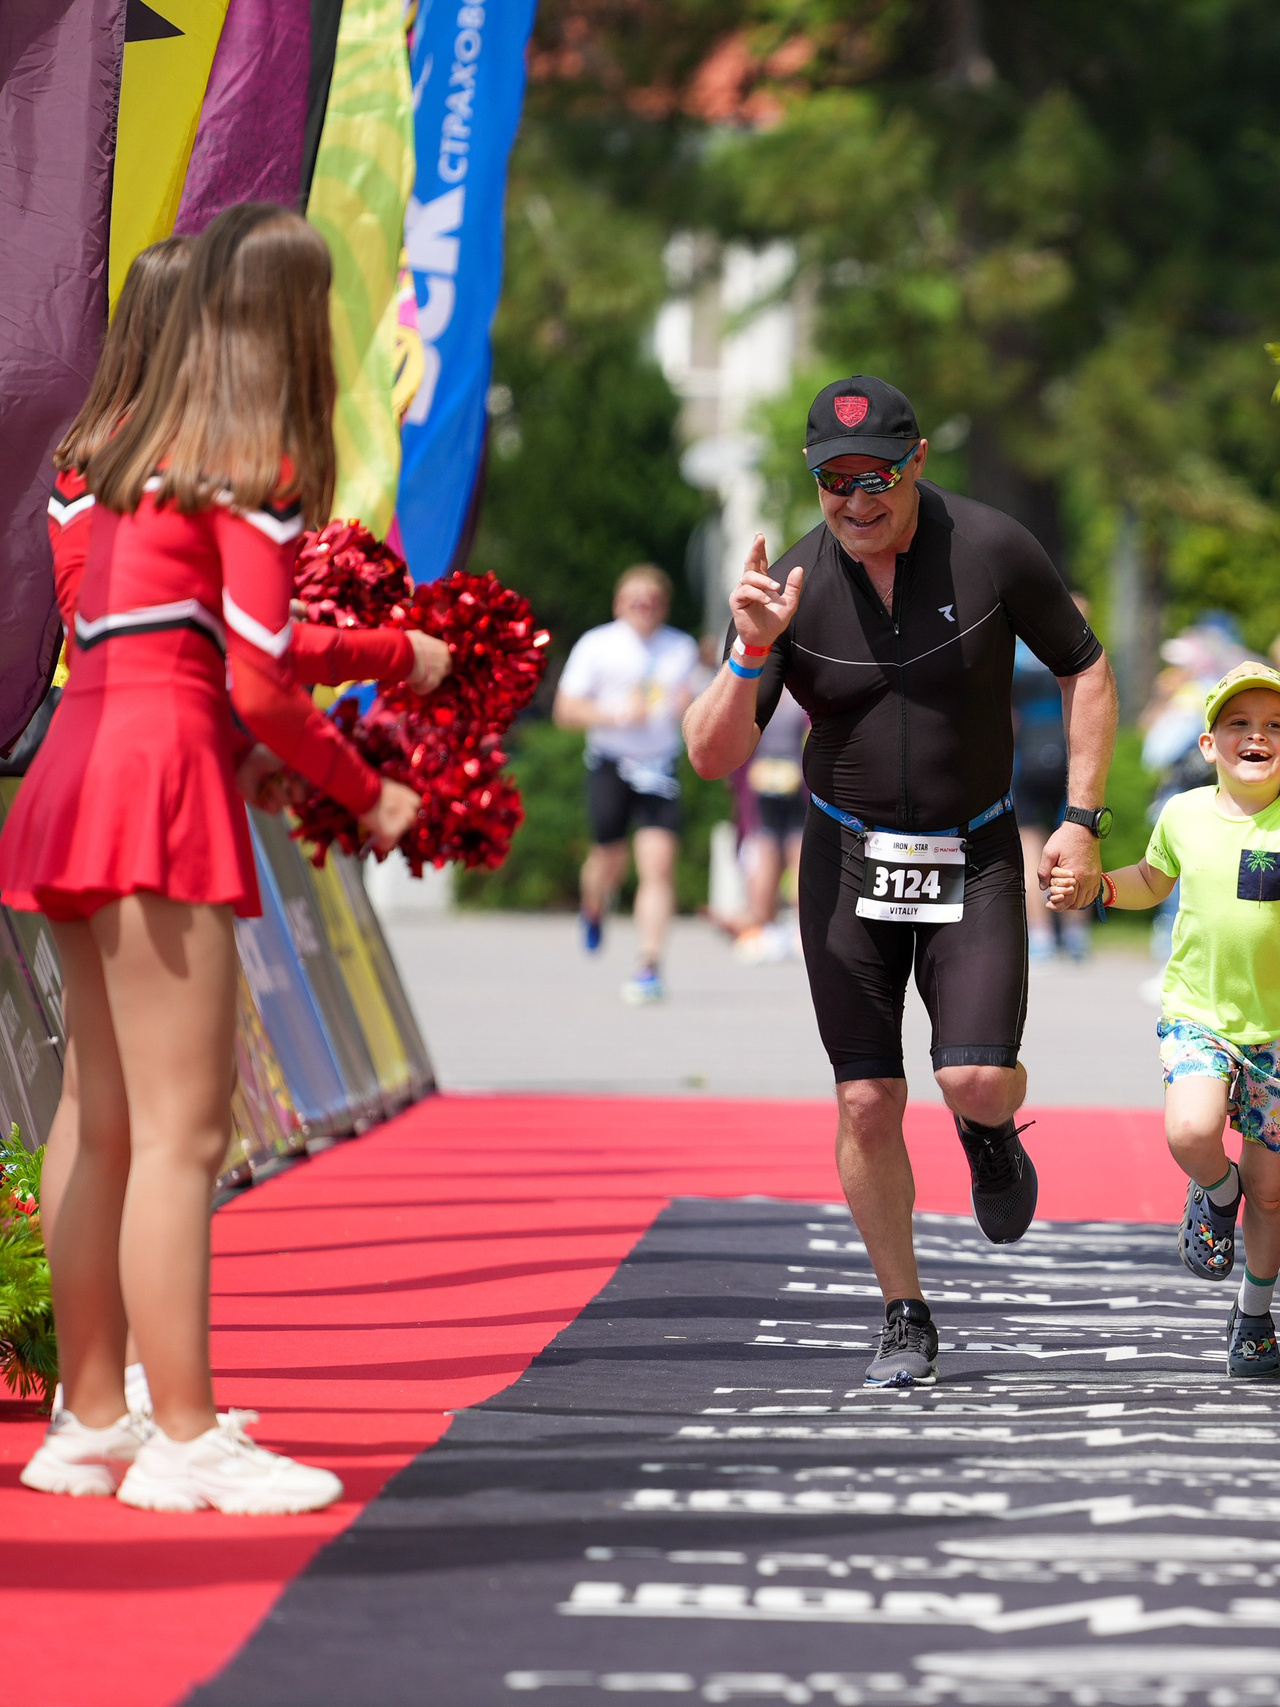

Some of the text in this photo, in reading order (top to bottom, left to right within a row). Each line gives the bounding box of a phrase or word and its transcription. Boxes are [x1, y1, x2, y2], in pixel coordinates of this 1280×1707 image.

[436, 0, 486, 183] СТРАХОВ
[893, 842, 929, 851] IRON STAR
[872, 866, 941, 899] 3124
[889, 906, 919, 915] VITALIY
